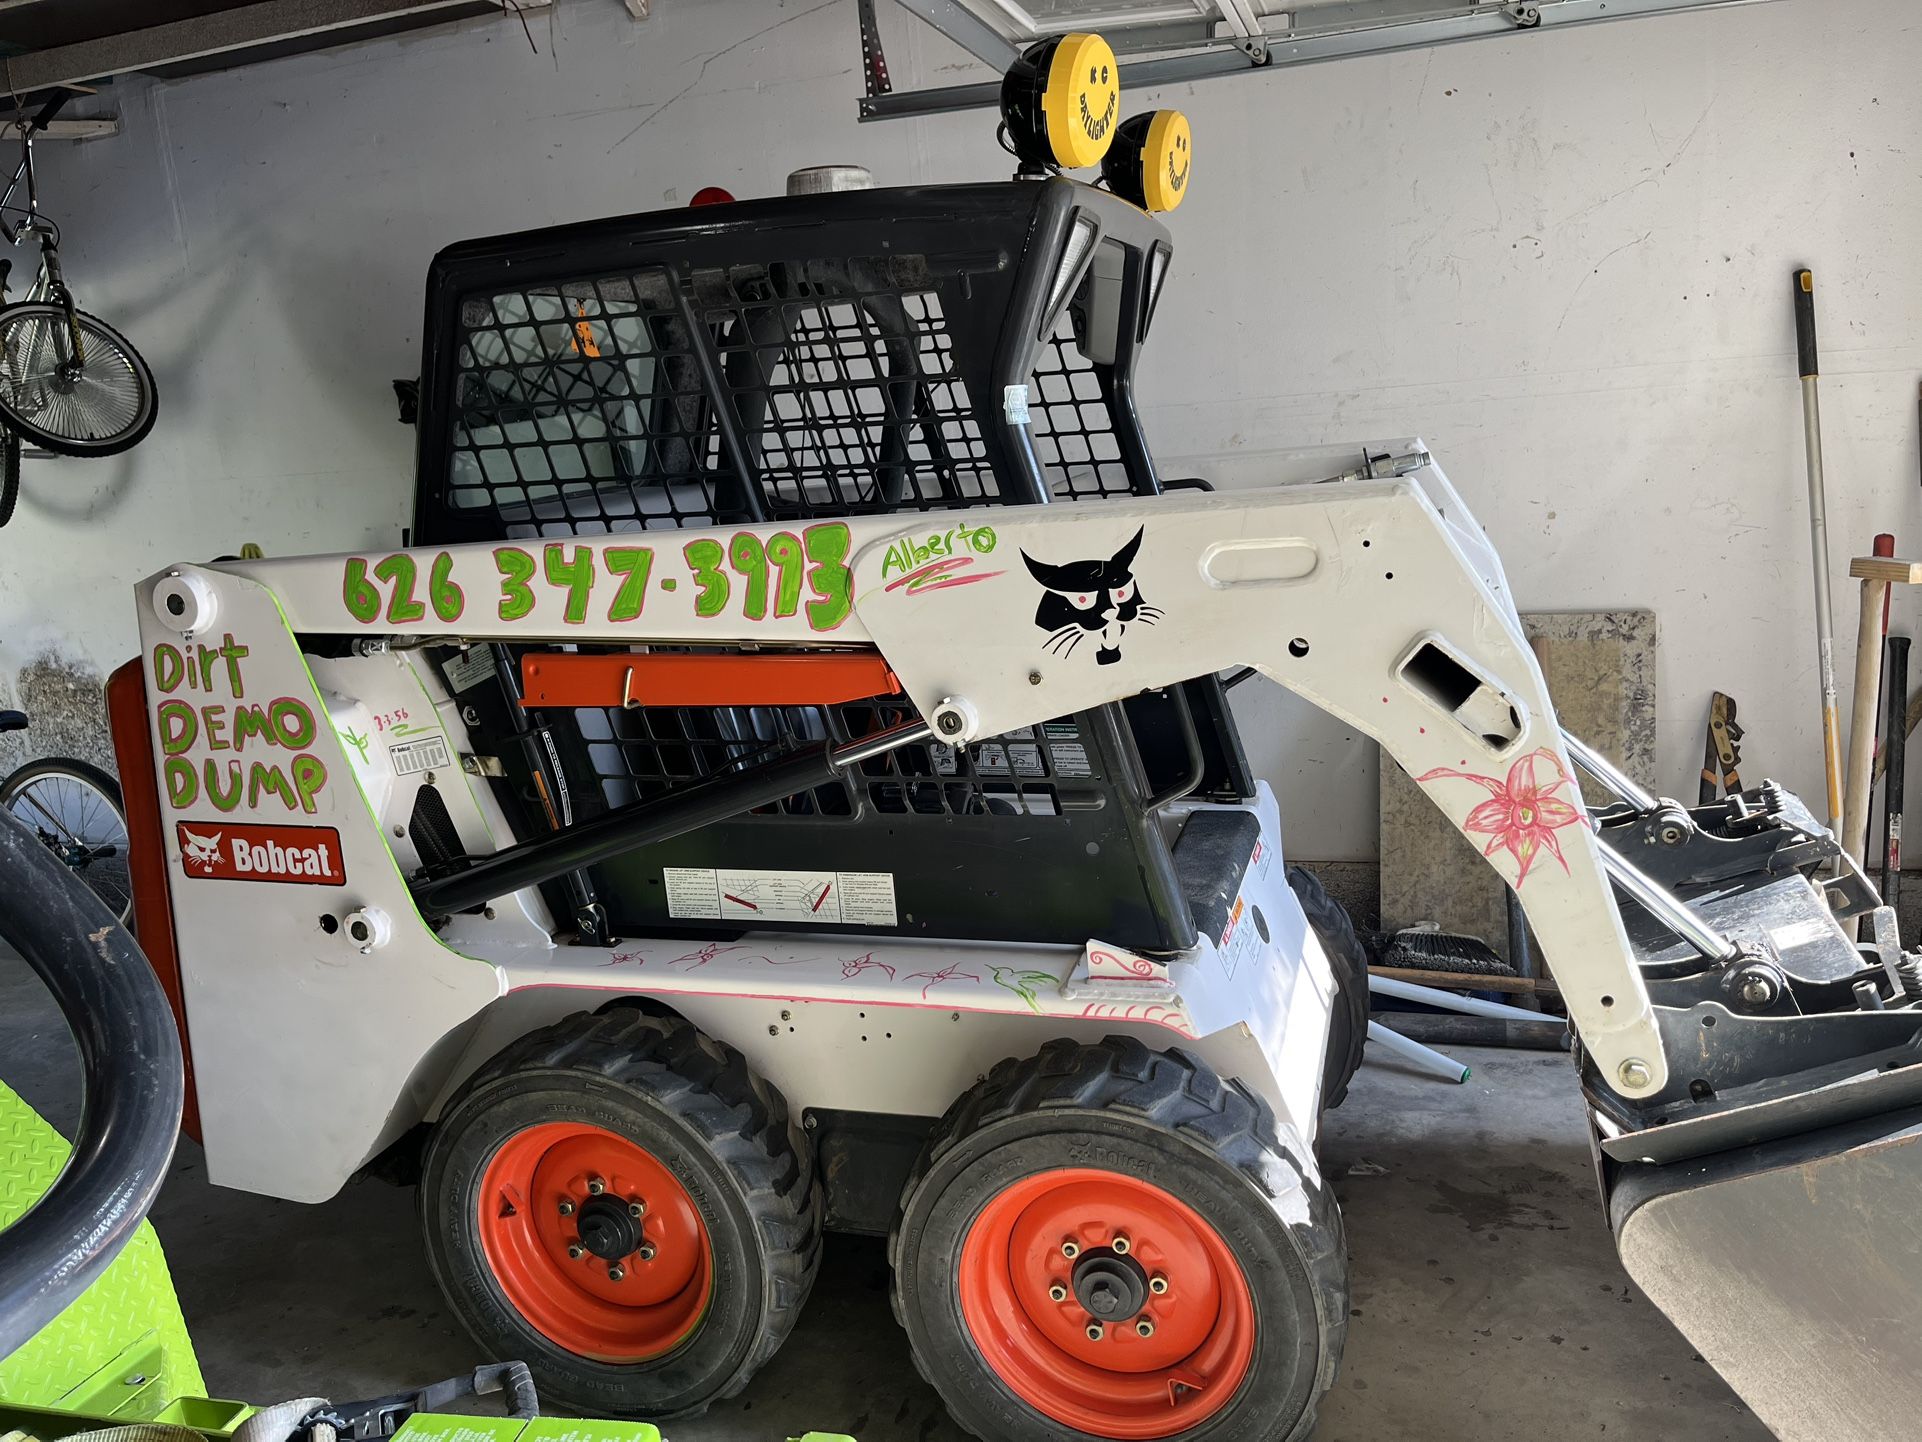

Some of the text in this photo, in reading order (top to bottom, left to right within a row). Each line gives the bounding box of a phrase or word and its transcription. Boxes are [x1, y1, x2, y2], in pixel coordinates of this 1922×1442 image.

[1079, 90, 1116, 141] DAYLIGHTER
[881, 522, 996, 580] Alberto
[343, 551, 464, 624] 626
[153, 633, 249, 699] Dirt
[157, 696, 317, 756] DEMO
[163, 753, 328, 814] DUMP
[231, 838, 332, 877] Bobcat
